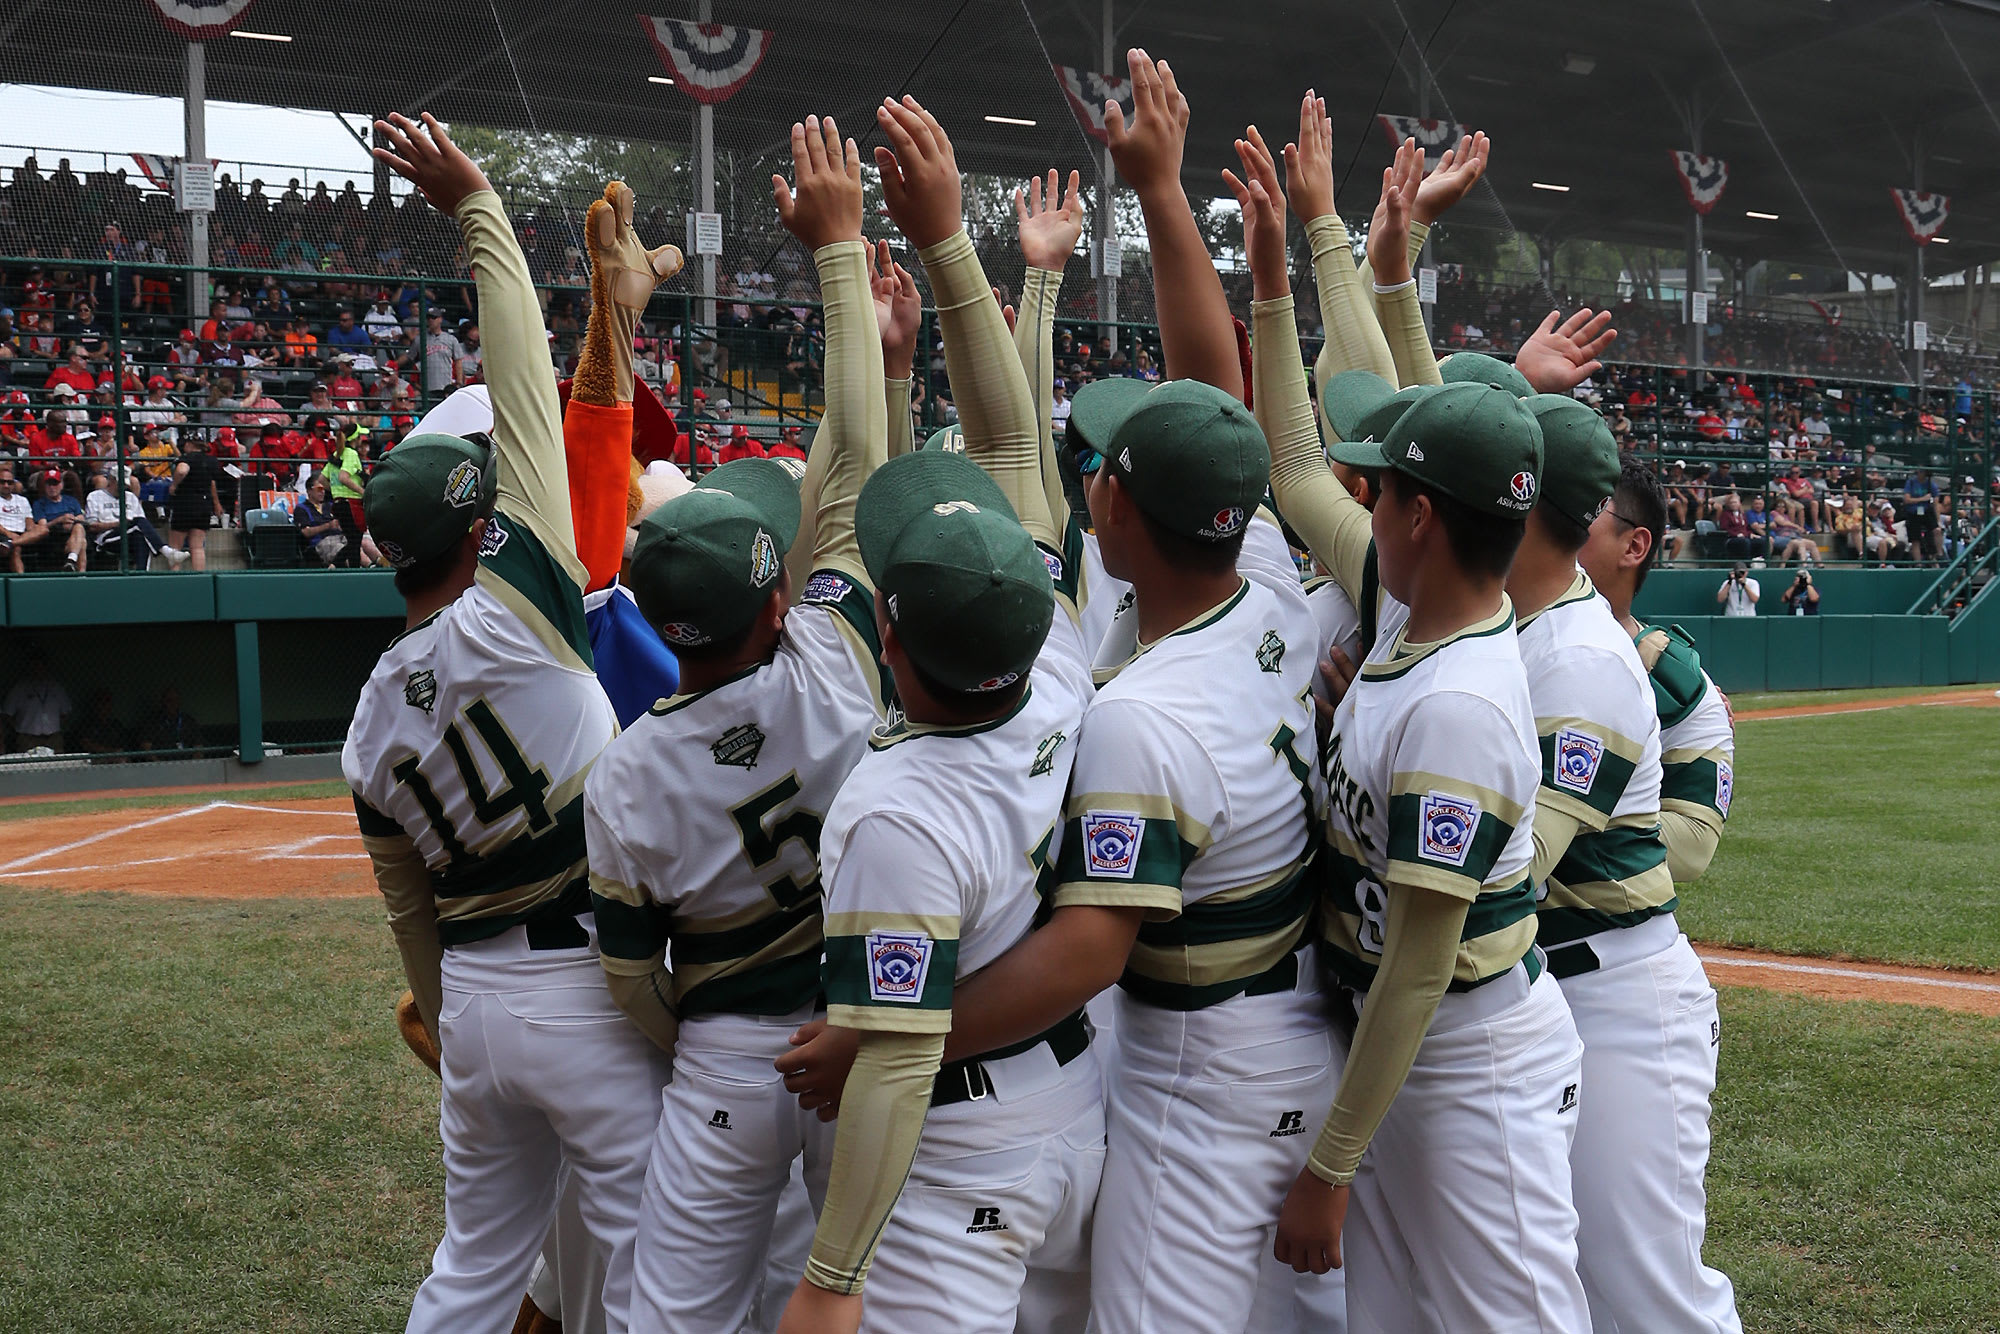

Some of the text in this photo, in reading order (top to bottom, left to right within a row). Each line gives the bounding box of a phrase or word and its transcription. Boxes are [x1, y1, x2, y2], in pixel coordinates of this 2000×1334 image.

[392, 692, 558, 866] 14
[725, 768, 823, 912] 5
[876, 945, 895, 957] LITTLE
[1355, 876, 1388, 956] 8
[966, 1224, 1009, 1234] RUSSELL
